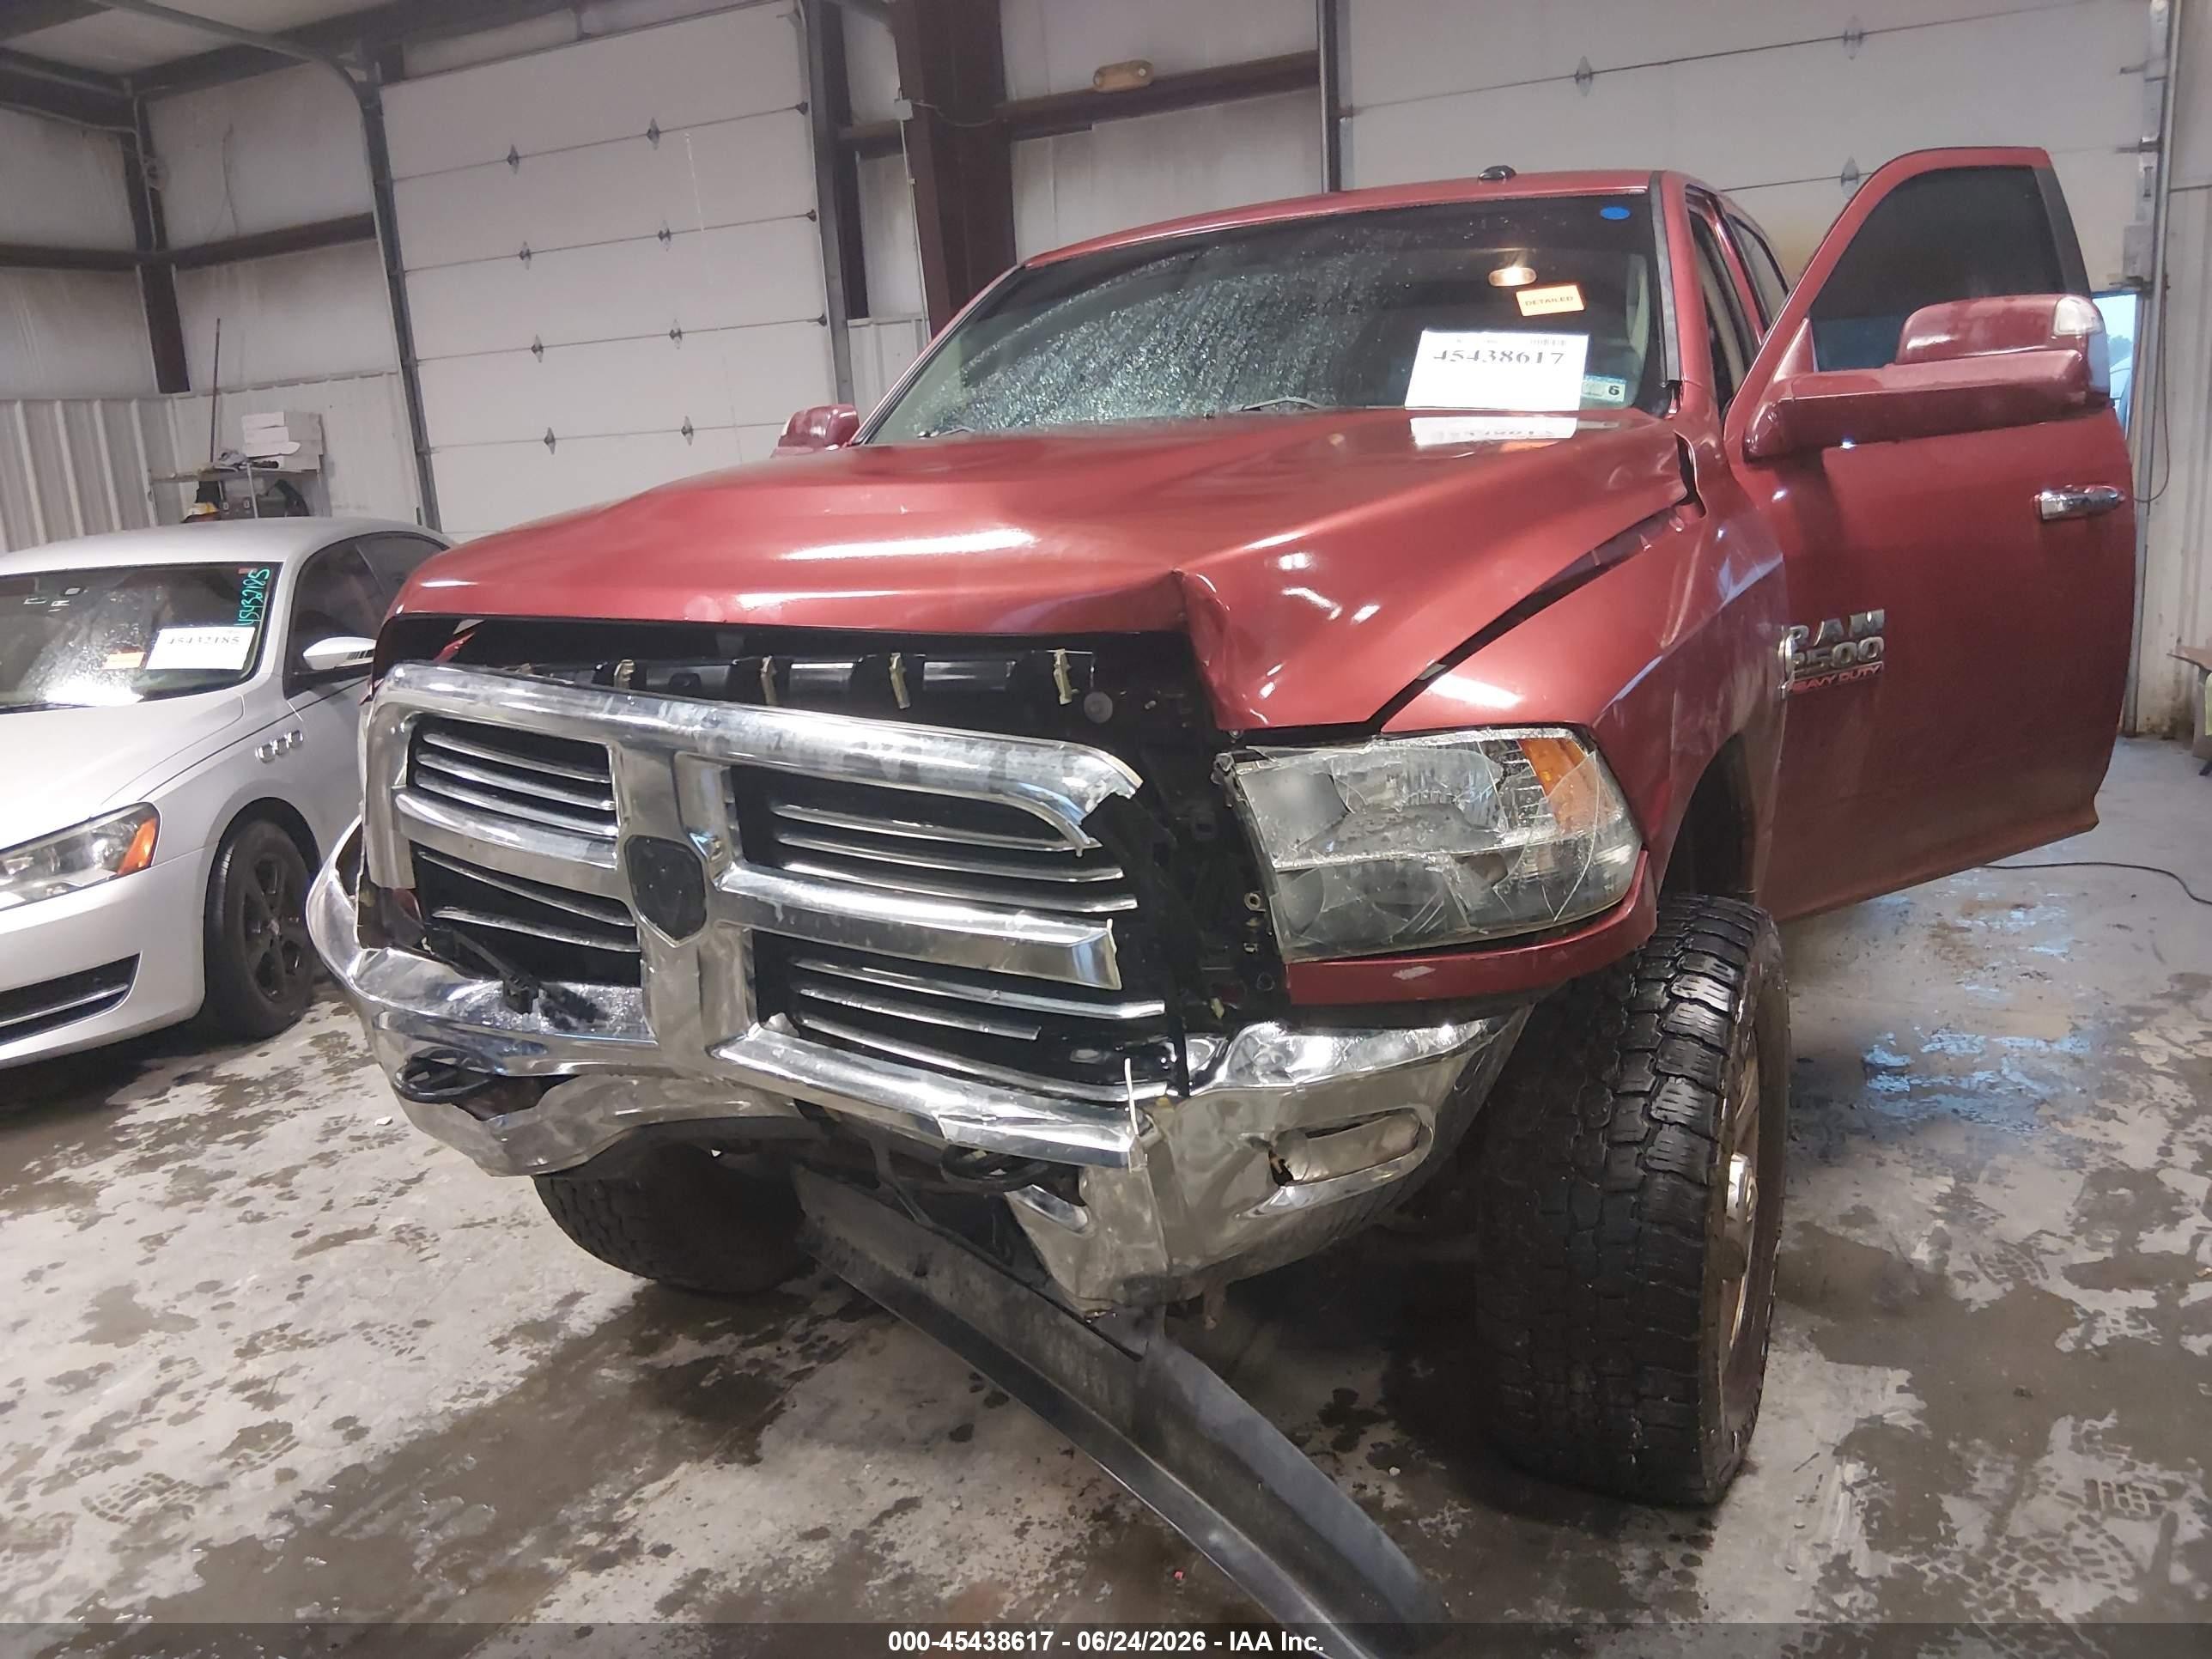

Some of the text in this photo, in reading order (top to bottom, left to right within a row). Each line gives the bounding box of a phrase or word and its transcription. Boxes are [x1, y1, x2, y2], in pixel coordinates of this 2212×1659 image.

[1524, 296, 1574, 307] DETAILED
[1432, 349, 1565, 365] 45438617
[1607, 385, 1620, 396] 6
[1785, 609, 1885, 648] RAM
[1838, 665, 1881, 683] DUTY
